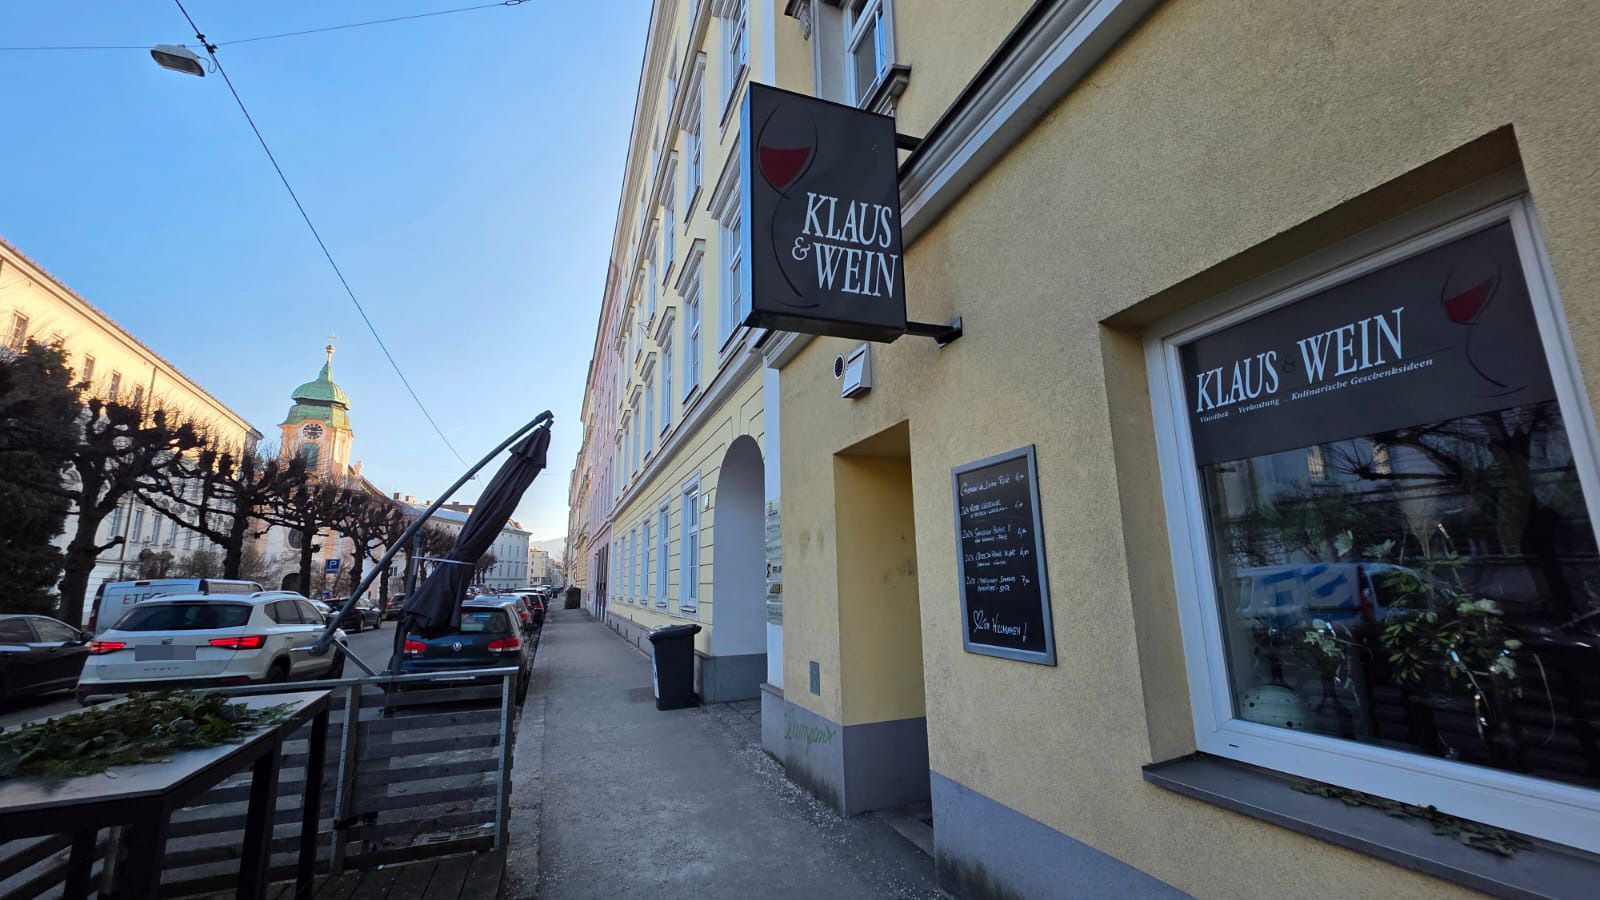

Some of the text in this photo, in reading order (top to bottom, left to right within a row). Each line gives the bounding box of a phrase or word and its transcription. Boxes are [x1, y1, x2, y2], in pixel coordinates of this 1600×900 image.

[802, 192, 892, 248] KLAUS
[791, 236, 898, 299] & WEIN
[1196, 350, 1279, 413] KLAUS
[1296, 306, 1404, 384] WEIN
[1238, 398, 1280, 414] Verkostung
[1291, 380, 1348, 401] Kulinarische
[329, 560, 337, 569] P
